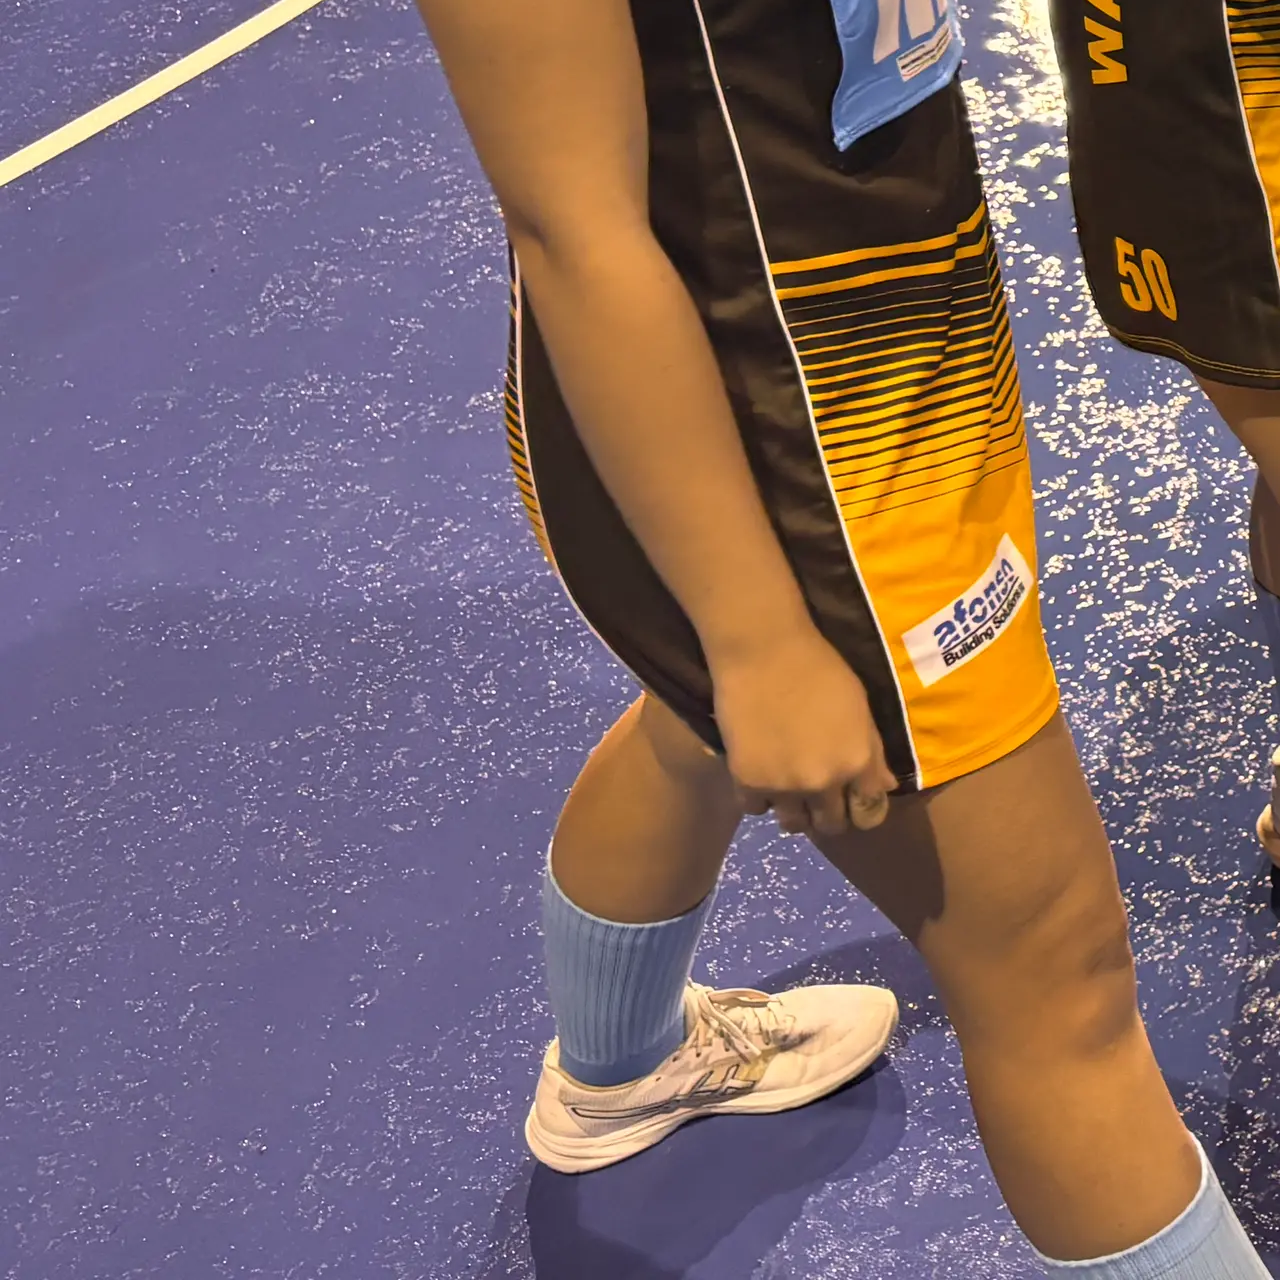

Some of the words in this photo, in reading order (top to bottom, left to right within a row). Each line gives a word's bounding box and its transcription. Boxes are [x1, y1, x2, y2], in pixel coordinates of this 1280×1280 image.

[1115, 236, 1178, 322] 50
[933, 558, 1014, 651] afonso
[942, 624, 995, 667] Building
